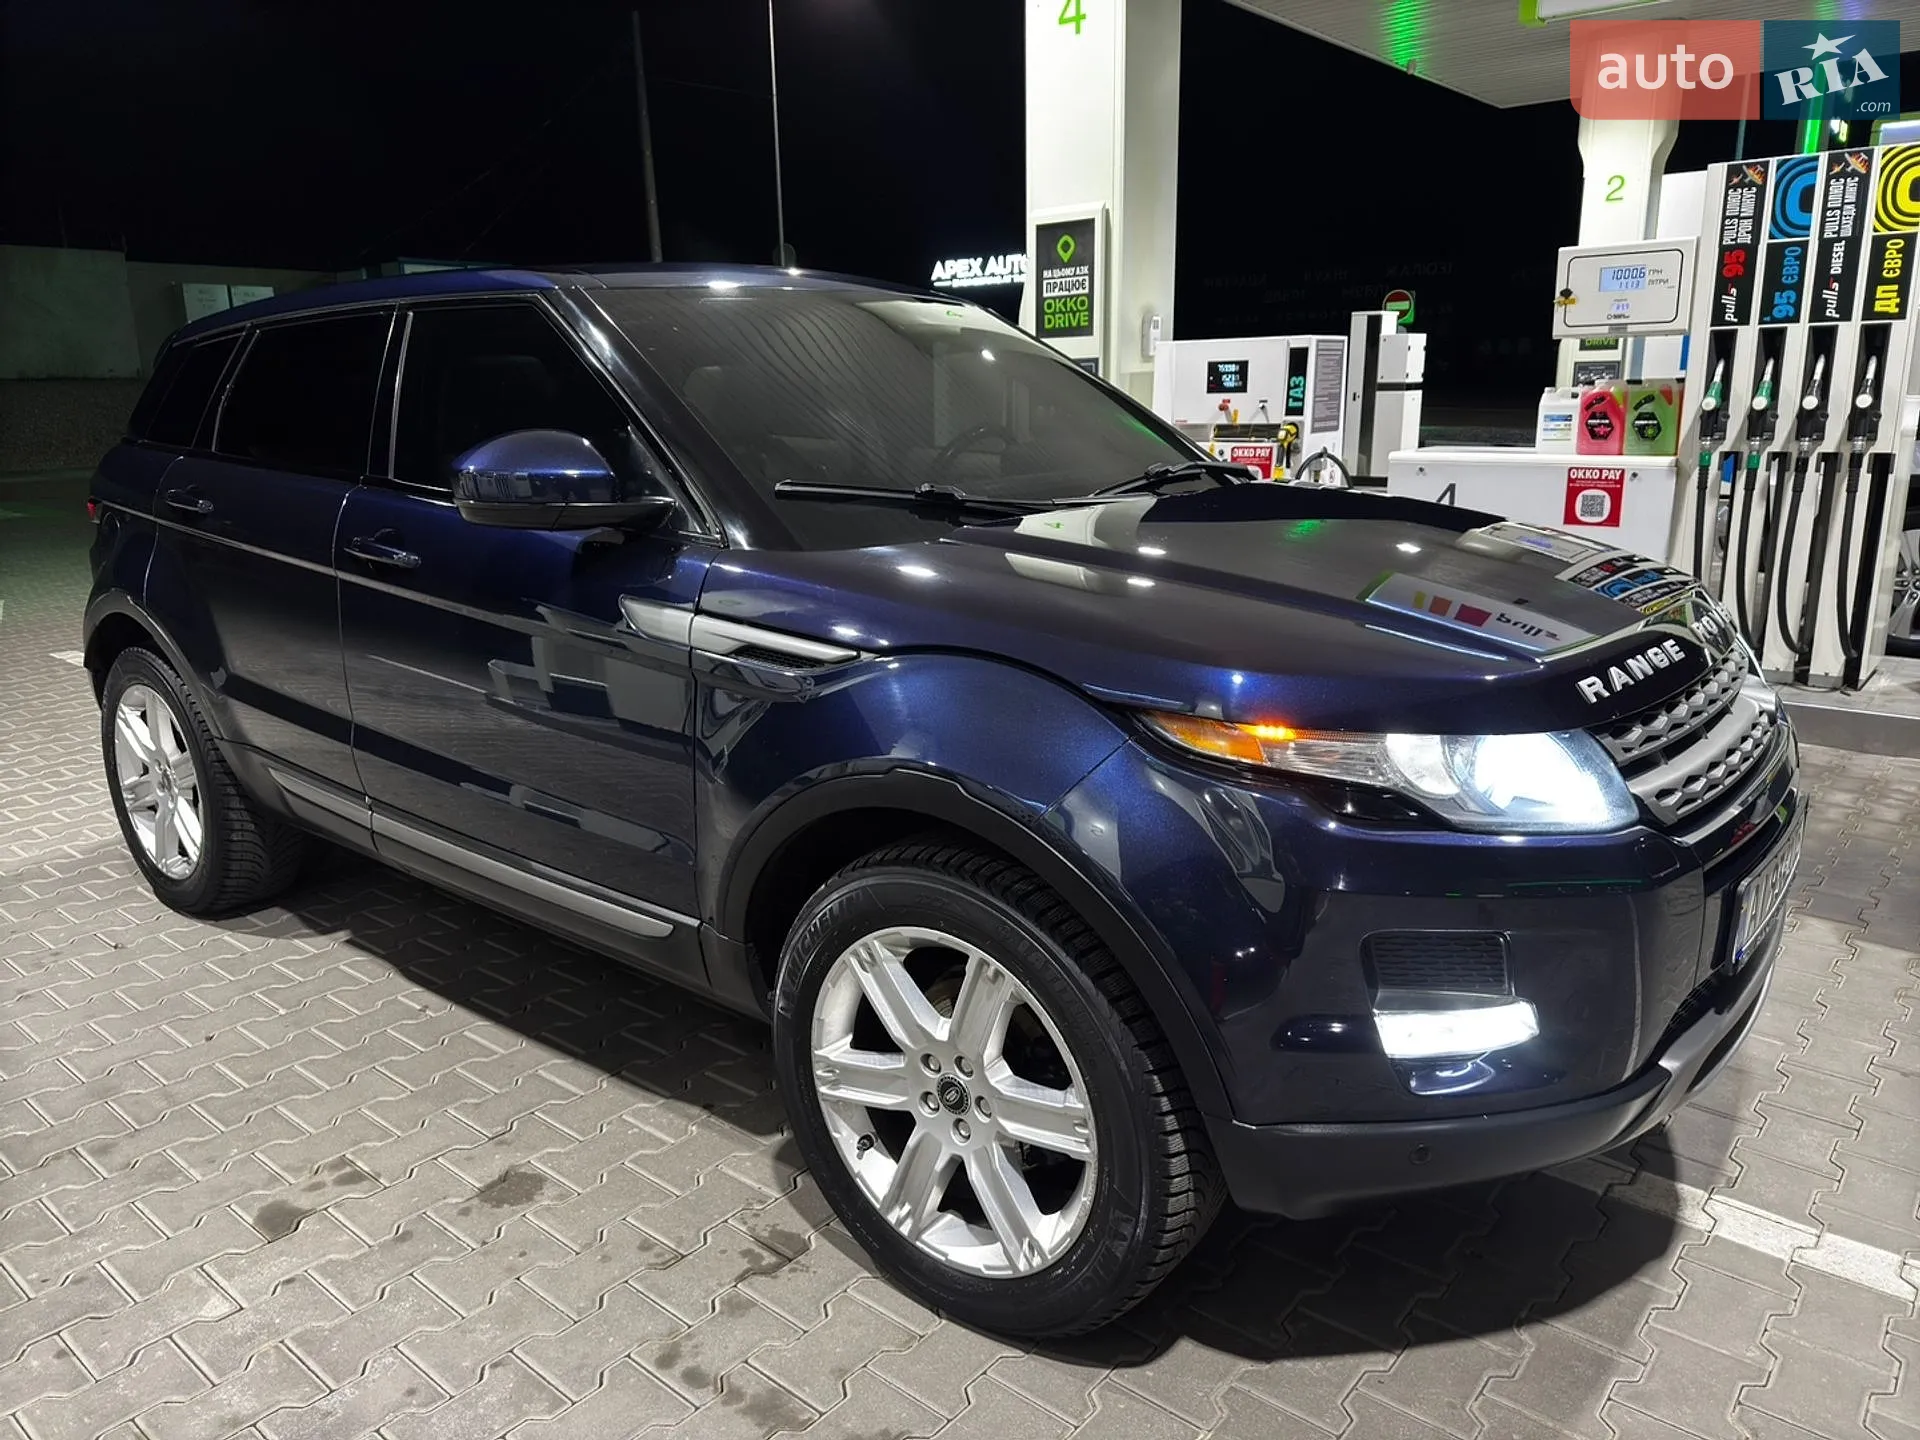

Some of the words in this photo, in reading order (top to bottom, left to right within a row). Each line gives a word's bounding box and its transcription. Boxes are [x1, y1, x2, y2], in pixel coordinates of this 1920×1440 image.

[1058, 0, 1087, 35] 4
[1605, 174, 1625, 201] 2
[1722, 218, 1739, 245] PULLS
[1823, 209, 1841, 239] PULLS
[930, 257, 983, 281] APEX
[1723, 249, 1746, 278] 95
[1781, 246, 1802, 285] ЄВРО
[1830, 240, 1846, 275] DIESEL
[1882, 238, 1905, 278] ЄВРО
[1045, 278, 1087, 294] ПРАЦЮЄ
[1822, 281, 1840, 319] pulls
[1874, 284, 1901, 314] ДП
[1043, 296, 1089, 313] OKKO
[1721, 286, 1738, 323] pulls
[1772, 290, 1797, 319] 95
[1044, 312, 1089, 329] DRIVE
[1288, 375, 1305, 408] ГАЗ
[1255, 446, 1272, 457] PAY
[1569, 468, 1600, 480] OKKO
[1601, 469, 1622, 481] PAY
[1576, 638, 1687, 704] RANGE
